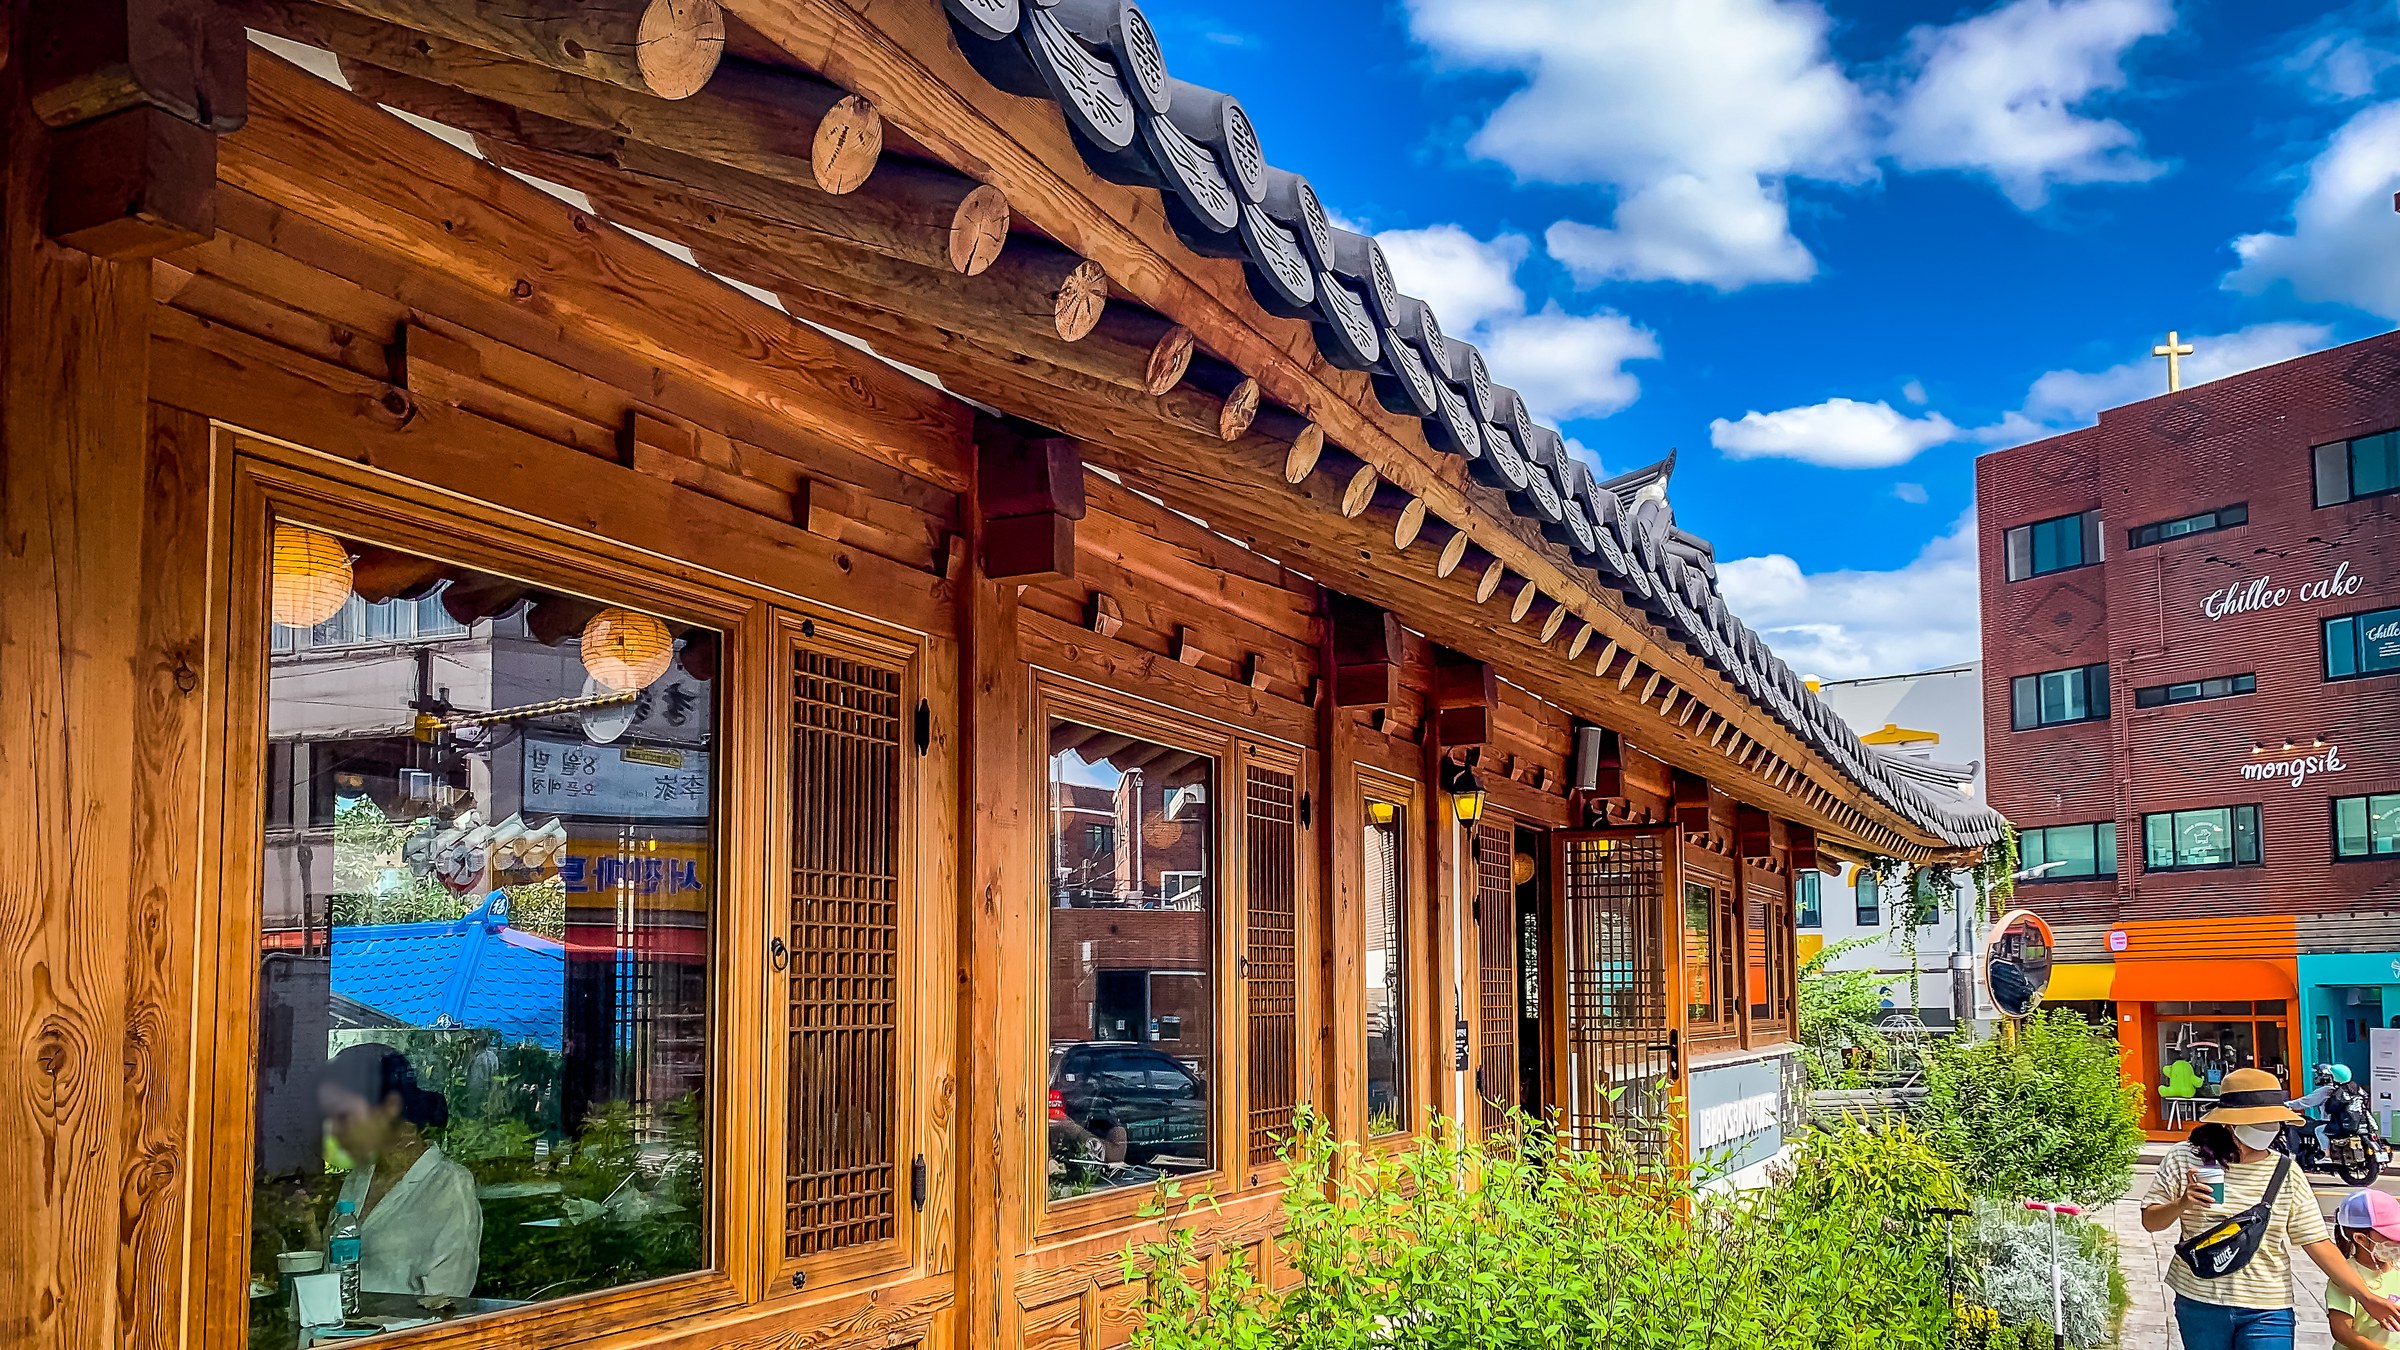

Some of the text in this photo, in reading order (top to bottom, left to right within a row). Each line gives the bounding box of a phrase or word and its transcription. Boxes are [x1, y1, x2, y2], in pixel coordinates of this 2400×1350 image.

[2299, 560, 2364, 602] cake
[2240, 745, 2347, 788] mongsik
[2213, 1245, 2232, 1266] NIKE
